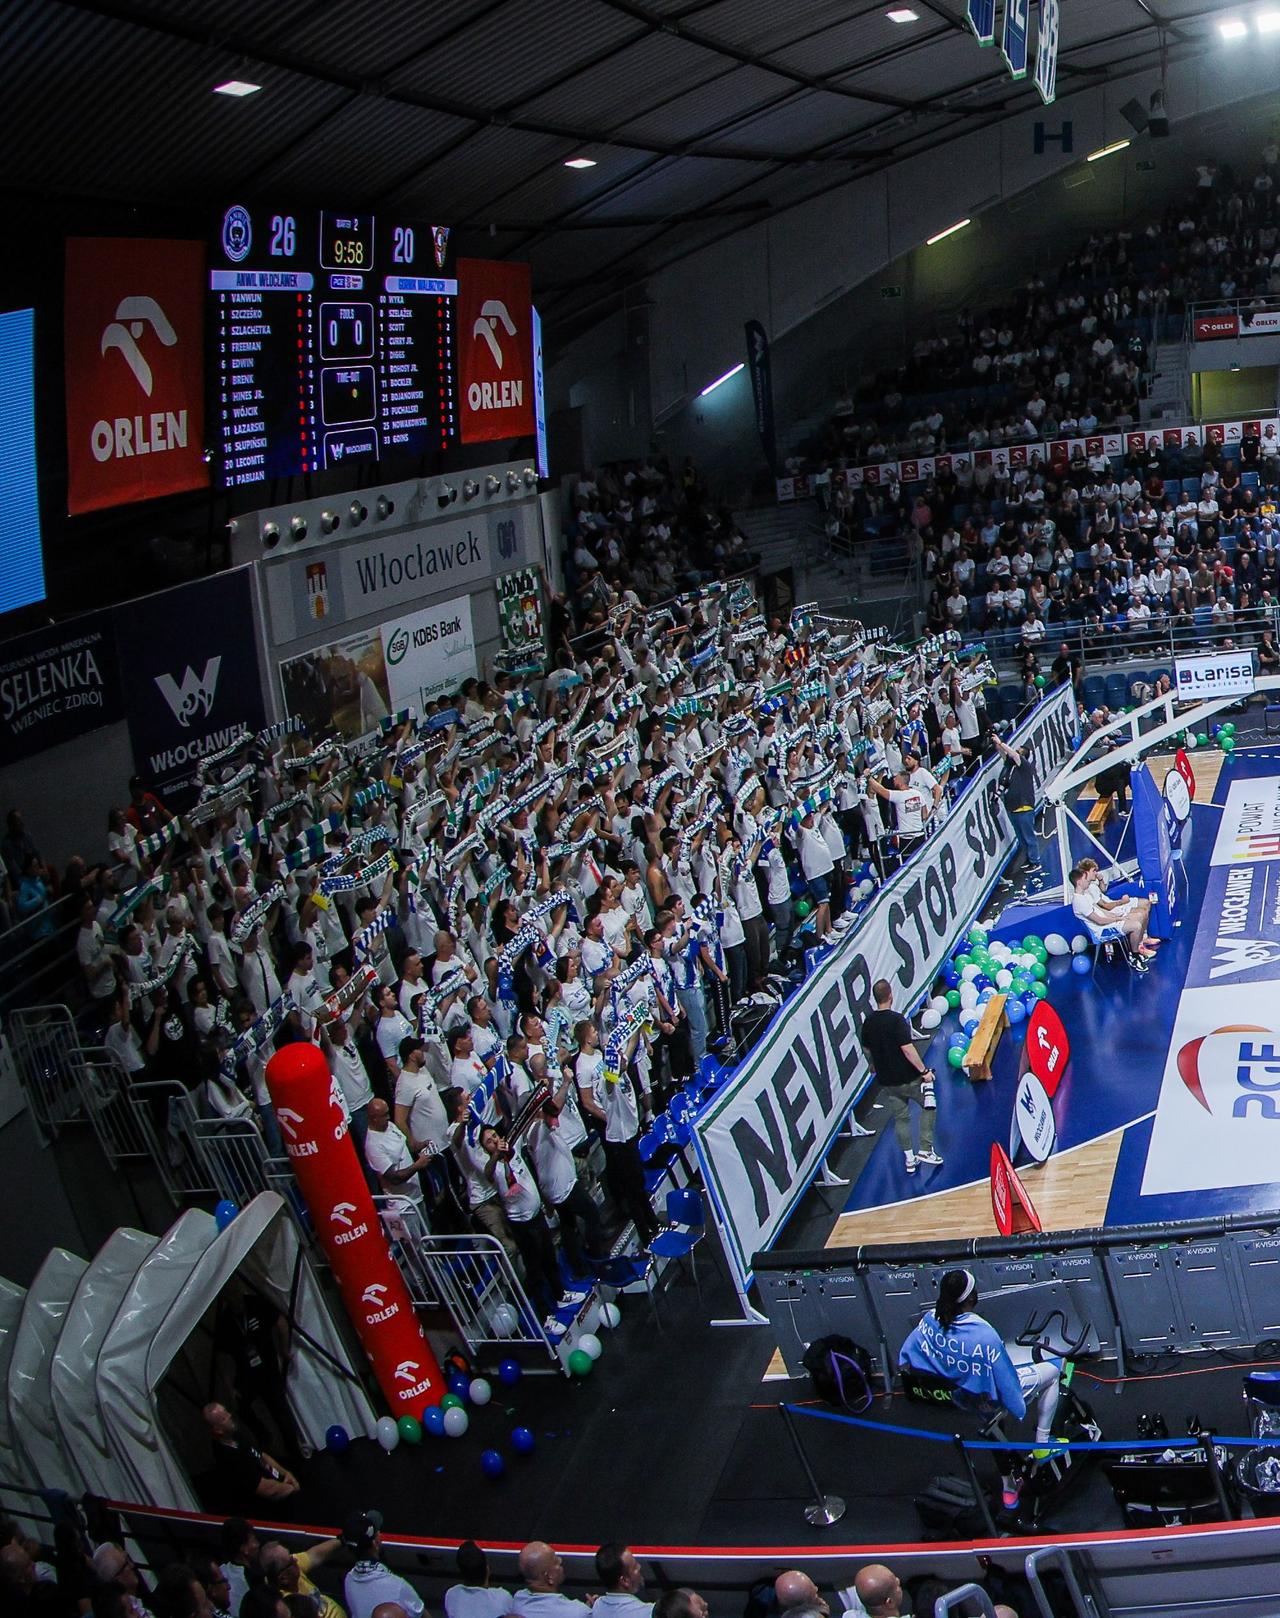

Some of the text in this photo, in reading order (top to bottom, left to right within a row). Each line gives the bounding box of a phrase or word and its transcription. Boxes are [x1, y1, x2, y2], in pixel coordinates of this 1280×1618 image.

[1034, 122, 1072, 154] H
[271, 215, 295, 256] 26
[354, 219, 358, 231] 2
[334, 240, 363, 264] 9:58
[394, 227, 414, 263] 20
[389, 296, 404, 304] WYKA
[340, 309, 354, 319] FOULS
[1255, 319, 1277, 327] ORLEN
[231, 326, 271, 336] SZLACHETKA
[330, 320, 362, 346] 0 0
[1211, 322, 1233, 331] ORLEN
[231, 342, 261, 352] FREEMAN
[232, 358, 254, 368] EDWIN
[232, 375, 254, 385] BRENK
[232, 391, 252, 401] HINES
[467, 379, 523, 410] ORLEN
[392, 418, 427, 429] NOWAKOWSKI
[91, 410, 188, 462] ORLEN
[356, 531, 482, 594] Włocławek
[392, 617, 462, 653] SGB KDBS Bank
[1193, 662, 1252, 682] Larisa
[0, 649, 103, 722] SELENKA
[10, 689, 103, 735] WIENIEC ZDRÓJ
[150, 721, 247, 774] WŁOCŁAWEK
[1238, 802, 1265, 834] POWIAT
[1217, 867, 1254, 936] WŁOCŁAWEK
[730, 704, 1075, 1228] NEVER STOP SUPRTING
[334, 1222, 367, 1247] ORLEN
[1127, 1252, 1157, 1261] K-VISION
[1187, 1246, 1216, 1256] K-VISION
[1005, 1263, 1033, 1272] K-VISION
[1062, 1258, 1091, 1267] K-VISION
[828, 1276, 855, 1285] K-VISION
[887, 1272, 915, 1281] K-VISION
[366, 1301, 399, 1326] ORLEN
[397, 1377, 430, 1401] ORLEN
